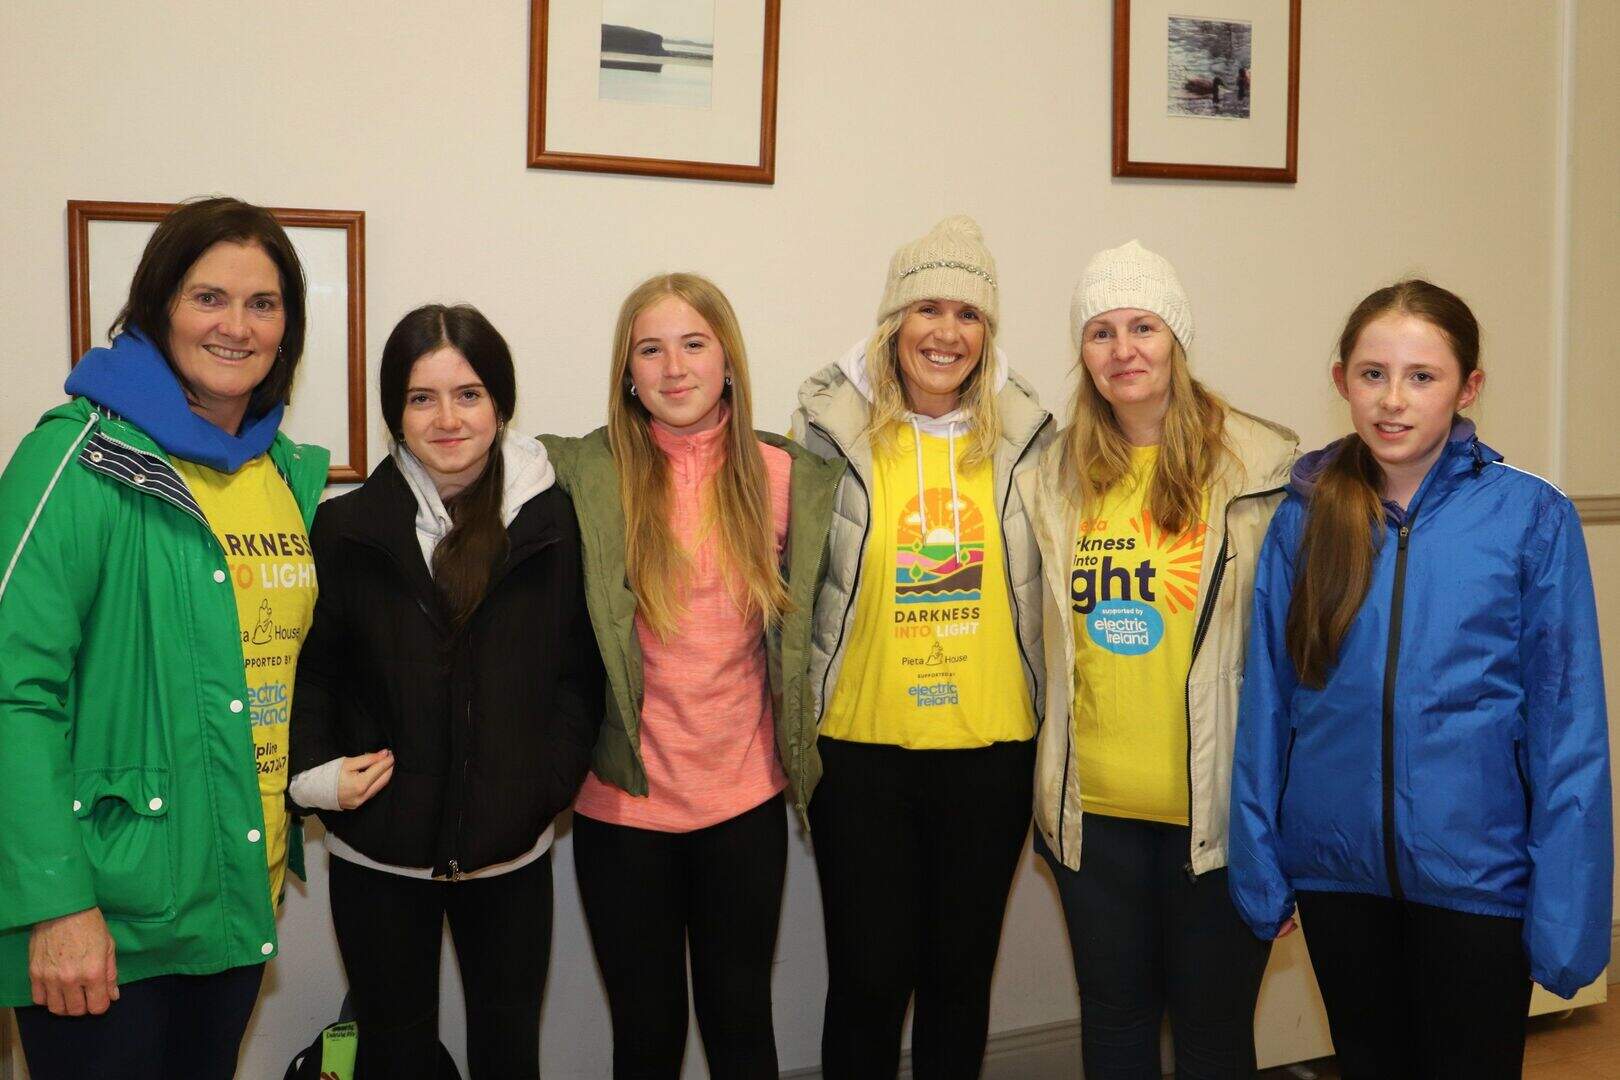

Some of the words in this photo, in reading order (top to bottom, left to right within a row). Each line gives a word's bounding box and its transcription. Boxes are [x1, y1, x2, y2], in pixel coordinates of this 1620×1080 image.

[221, 532, 312, 557] RKNESS
[1073, 554, 1099, 567] into
[260, 563, 316, 589] LIGHT
[1071, 555, 1157, 615] ght
[894, 607, 980, 623] DARKNESS
[1102, 607, 1135, 616] supported
[1135, 607, 1144, 616] by
[895, 625, 931, 639] INTO
[936, 622, 978, 637] LIGHT
[1094, 617, 1148, 632] electric
[901, 656, 925, 666] Pieta
[944, 654, 968, 664] House
[908, 681, 958, 696] electric
[254, 742, 278, 759] pline
